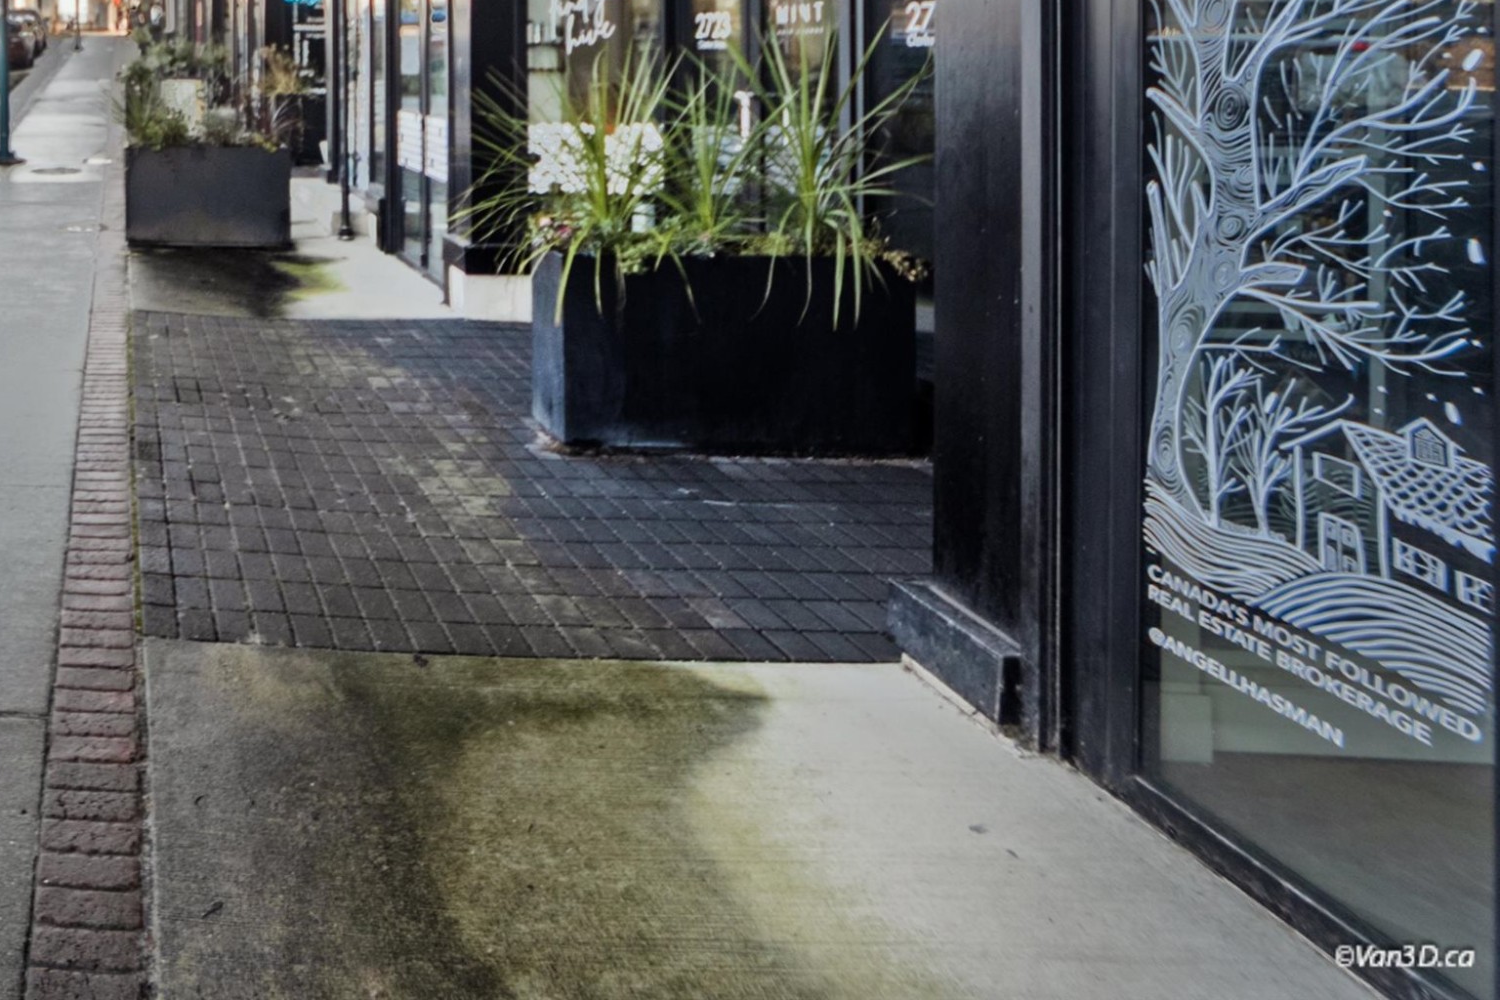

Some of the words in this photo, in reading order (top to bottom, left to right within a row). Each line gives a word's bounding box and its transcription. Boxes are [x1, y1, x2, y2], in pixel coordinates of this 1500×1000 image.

[775, 1, 824, 25] MINT
[1147, 563, 1250, 627] CANADA'S
[1253, 613, 1321, 661] MOST
[1325, 650, 1483, 744] FOLLOWED
[1147, 583, 1196, 623] REAL
[1199, 610, 1273, 662] ESTATE
[1275, 650, 1434, 748] BROKERAGE
[1148, 627, 1345, 749] @ANGELLHASMAN
